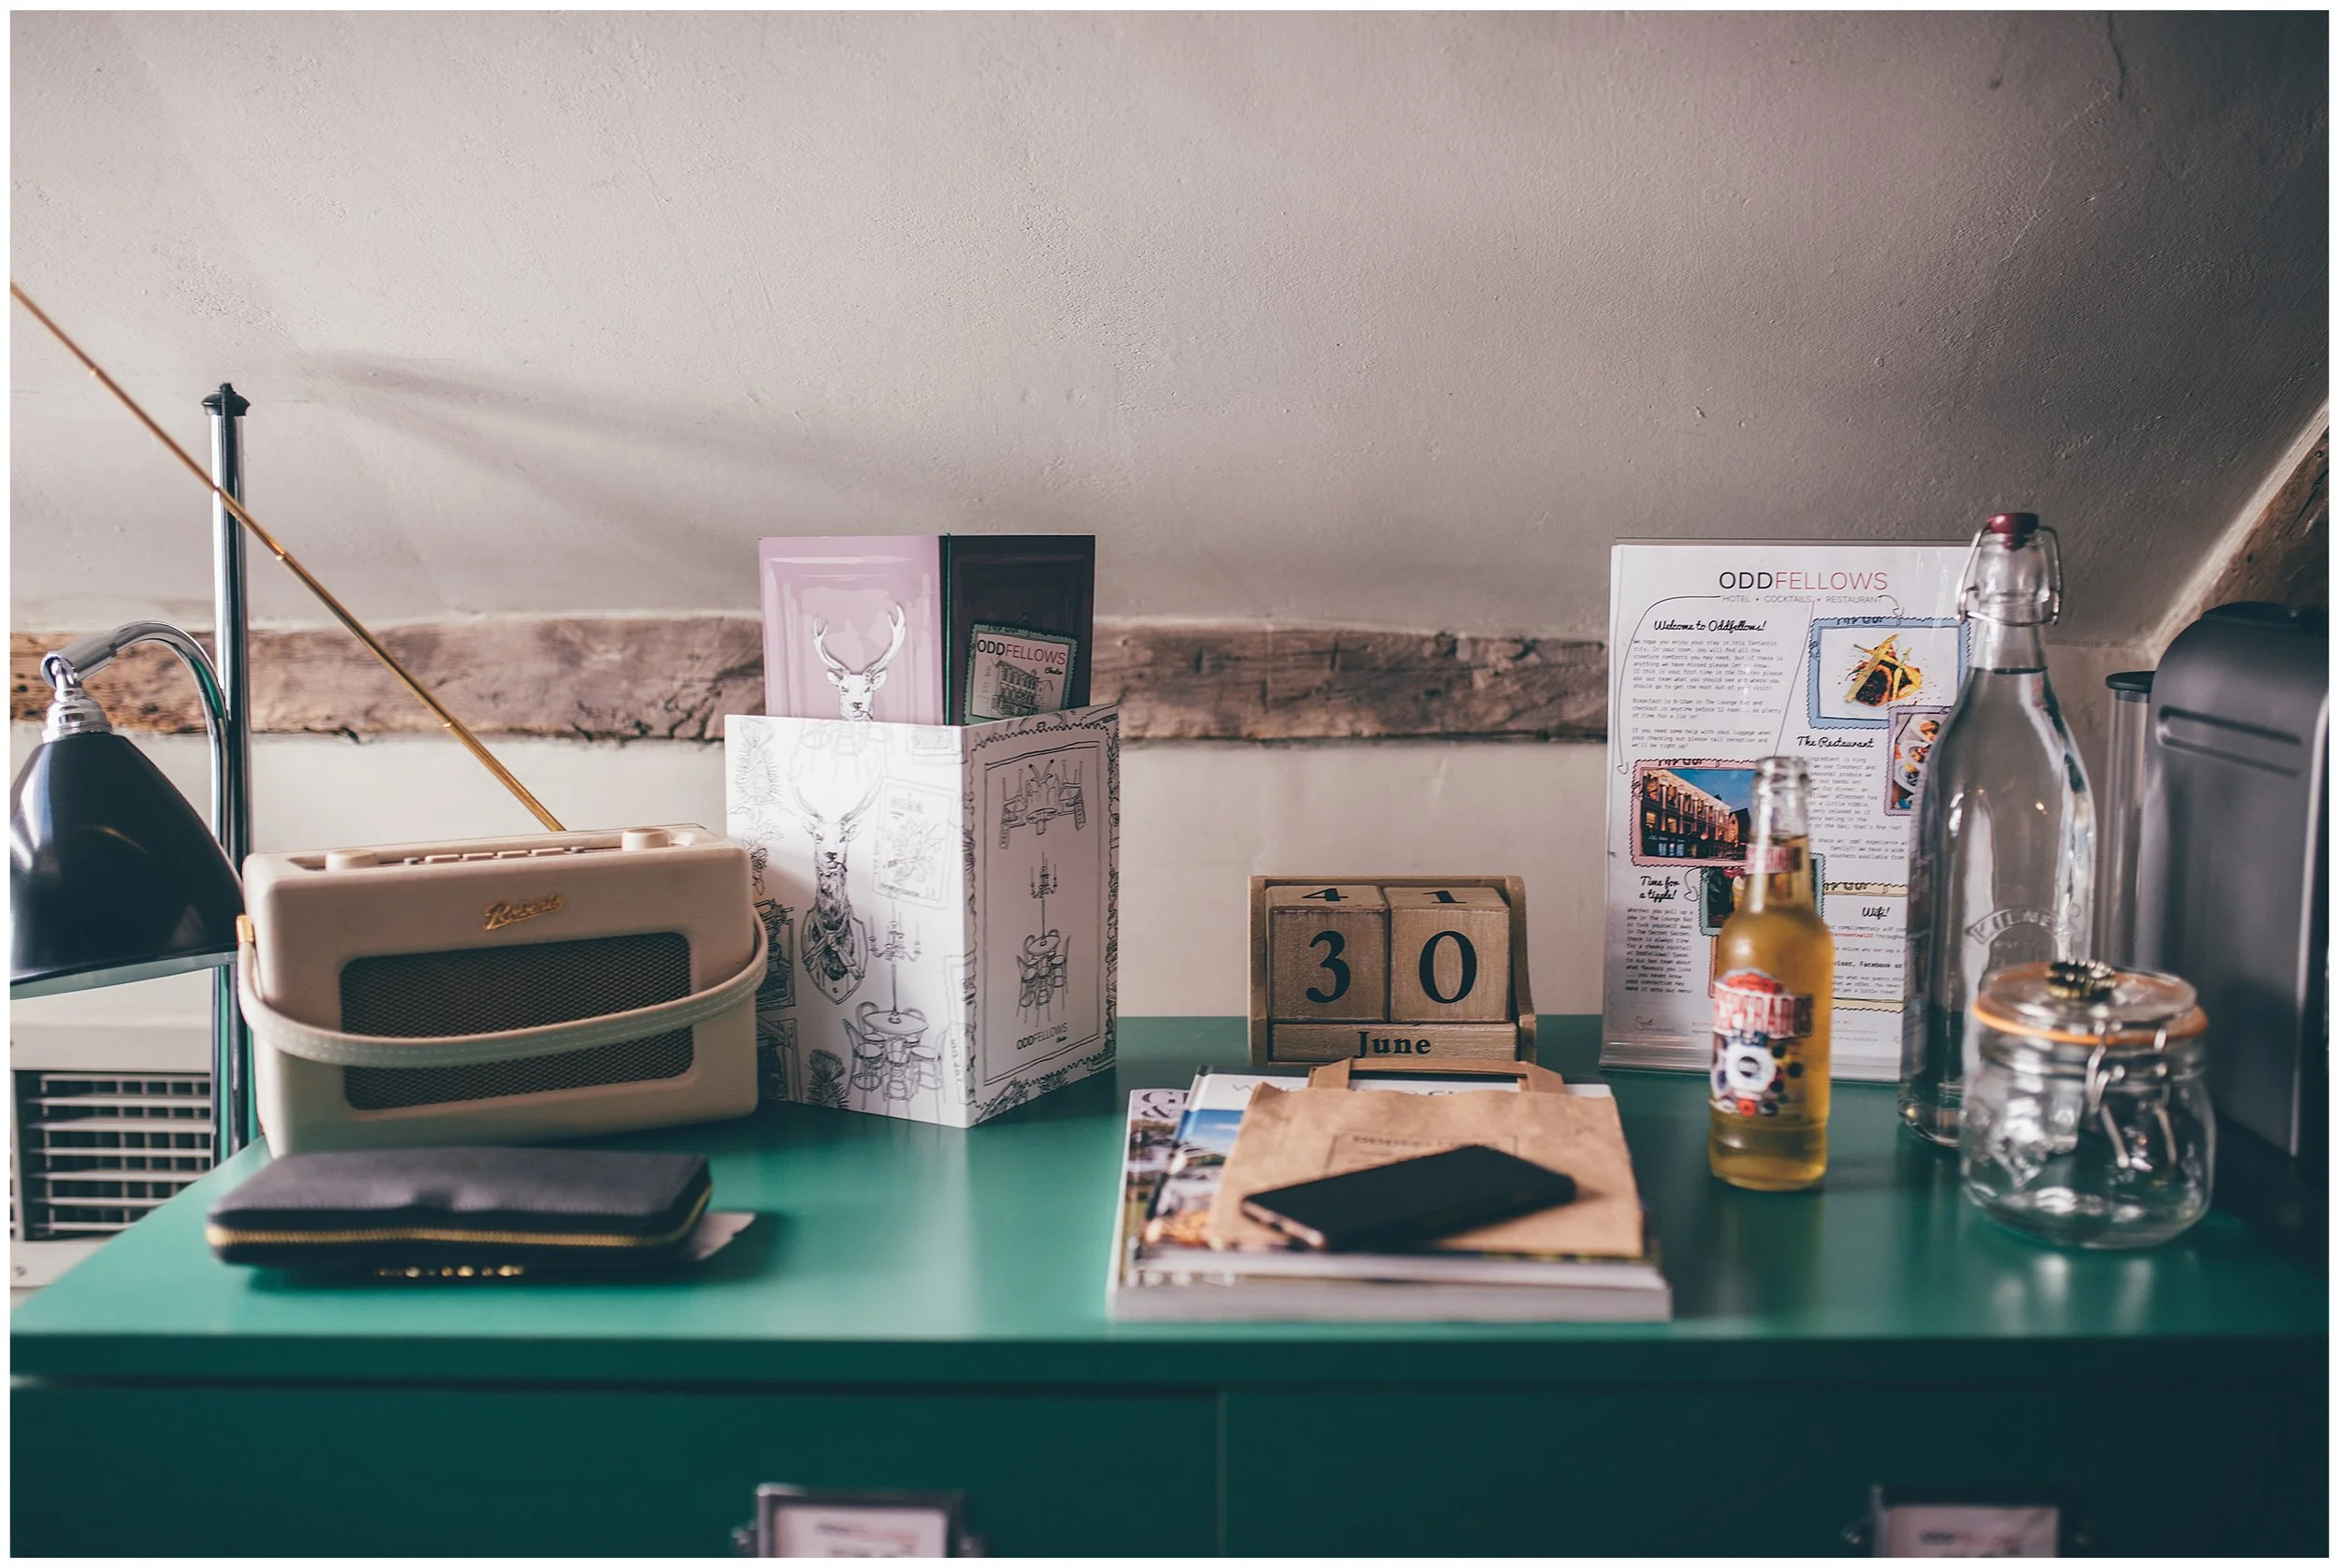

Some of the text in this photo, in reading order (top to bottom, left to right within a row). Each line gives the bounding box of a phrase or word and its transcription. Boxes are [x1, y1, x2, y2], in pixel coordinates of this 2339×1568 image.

[1720, 572, 1888, 590] ODDFELLOWS
[1654, 619, 1766, 633] Welcome to Oddfellows!
[977, 639, 1066, 665] ODDFELLOWS
[1796, 735, 1875, 748] The Restaurant
[1640, 876, 1680, 890] Time for
[1301, 888, 1467, 904] 4 1
[1647, 890, 1678, 903] tipple!
[1306, 930, 1477, 1004] 3 0
[1016, 1022, 1068, 1050] ODDFELLOWS
[1353, 1031, 1431, 1059] June
